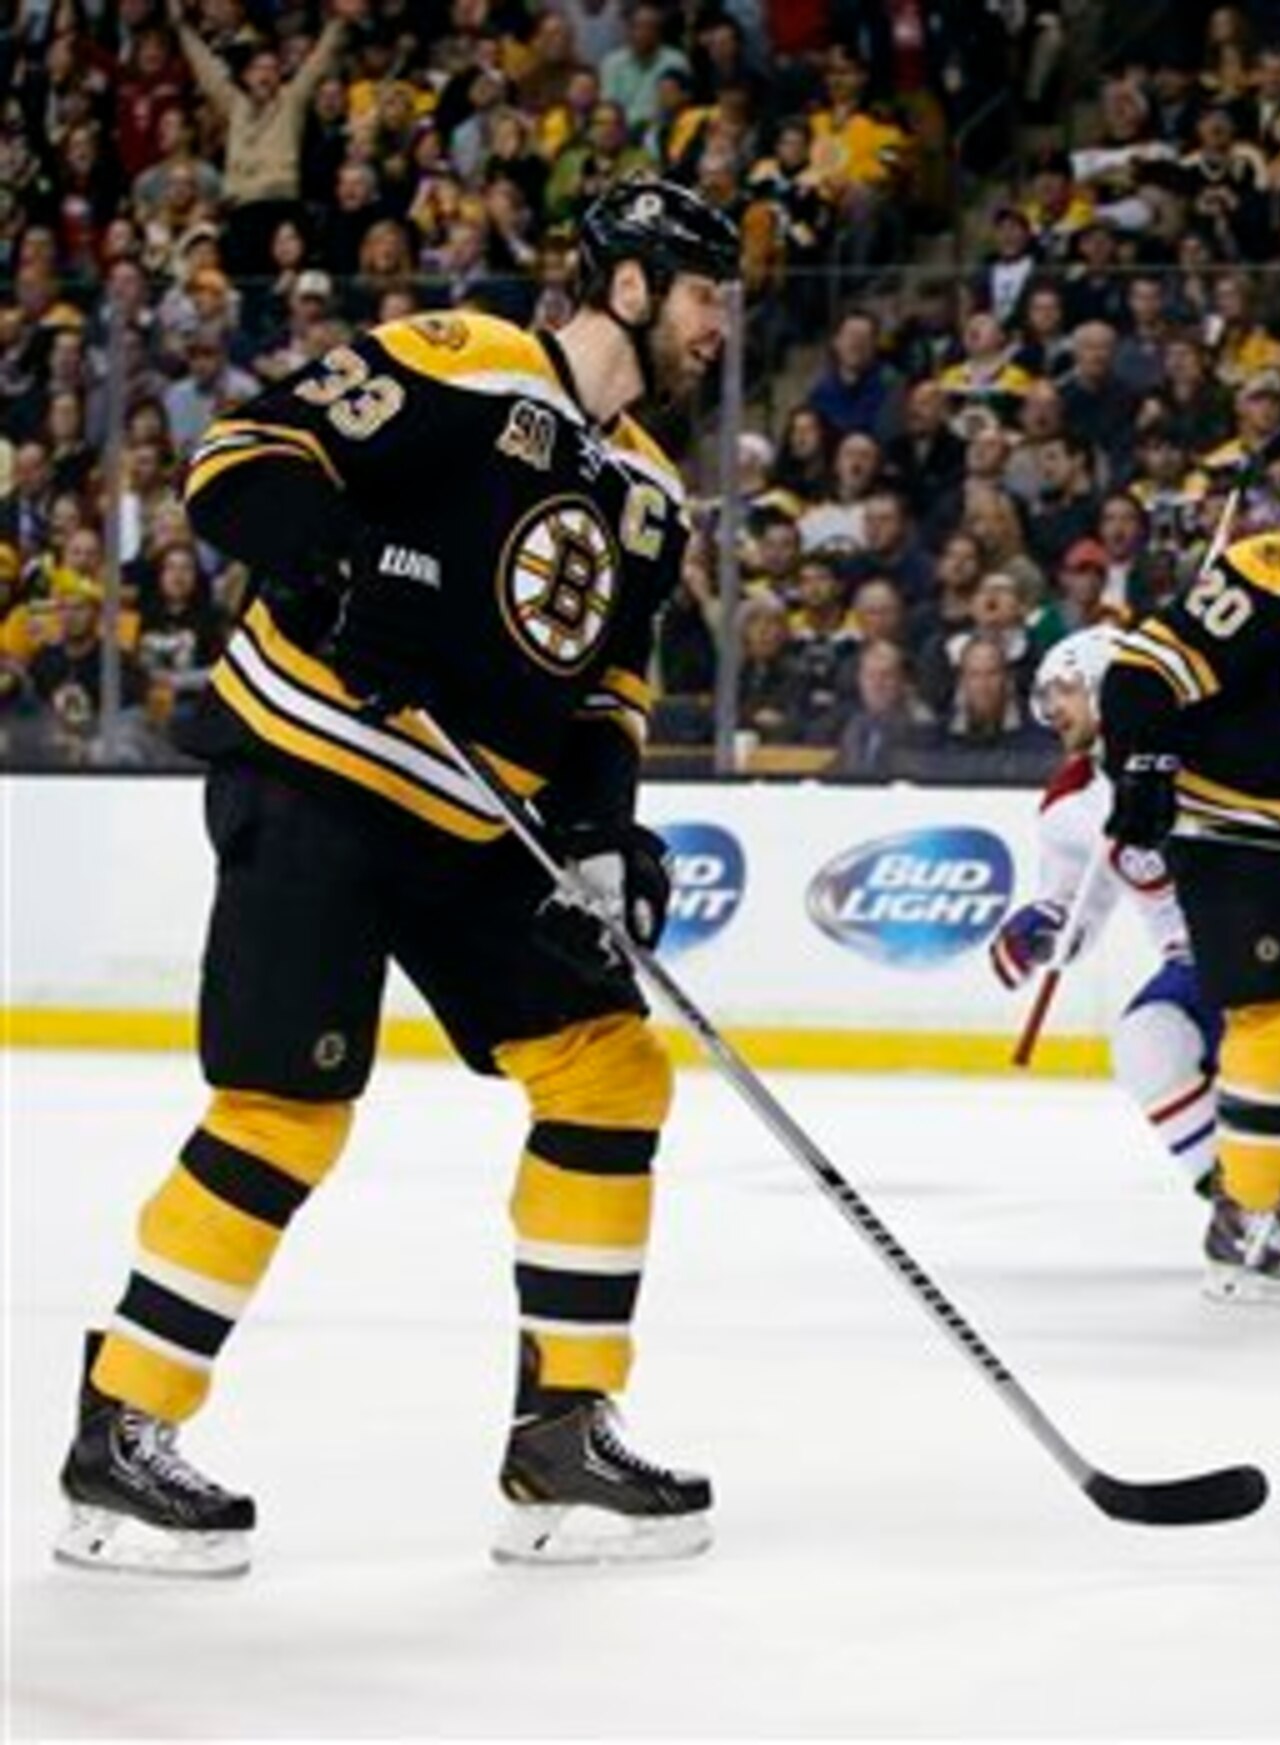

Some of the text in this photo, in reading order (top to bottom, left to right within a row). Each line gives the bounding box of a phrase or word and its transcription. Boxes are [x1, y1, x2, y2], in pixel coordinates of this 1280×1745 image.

[294, 344, 406, 442] 33
[620, 481, 668, 562] C
[1185, 567, 1253, 640] 20
[838, 889, 1006, 924] LIGHT
[866, 855, 992, 890] BUD
